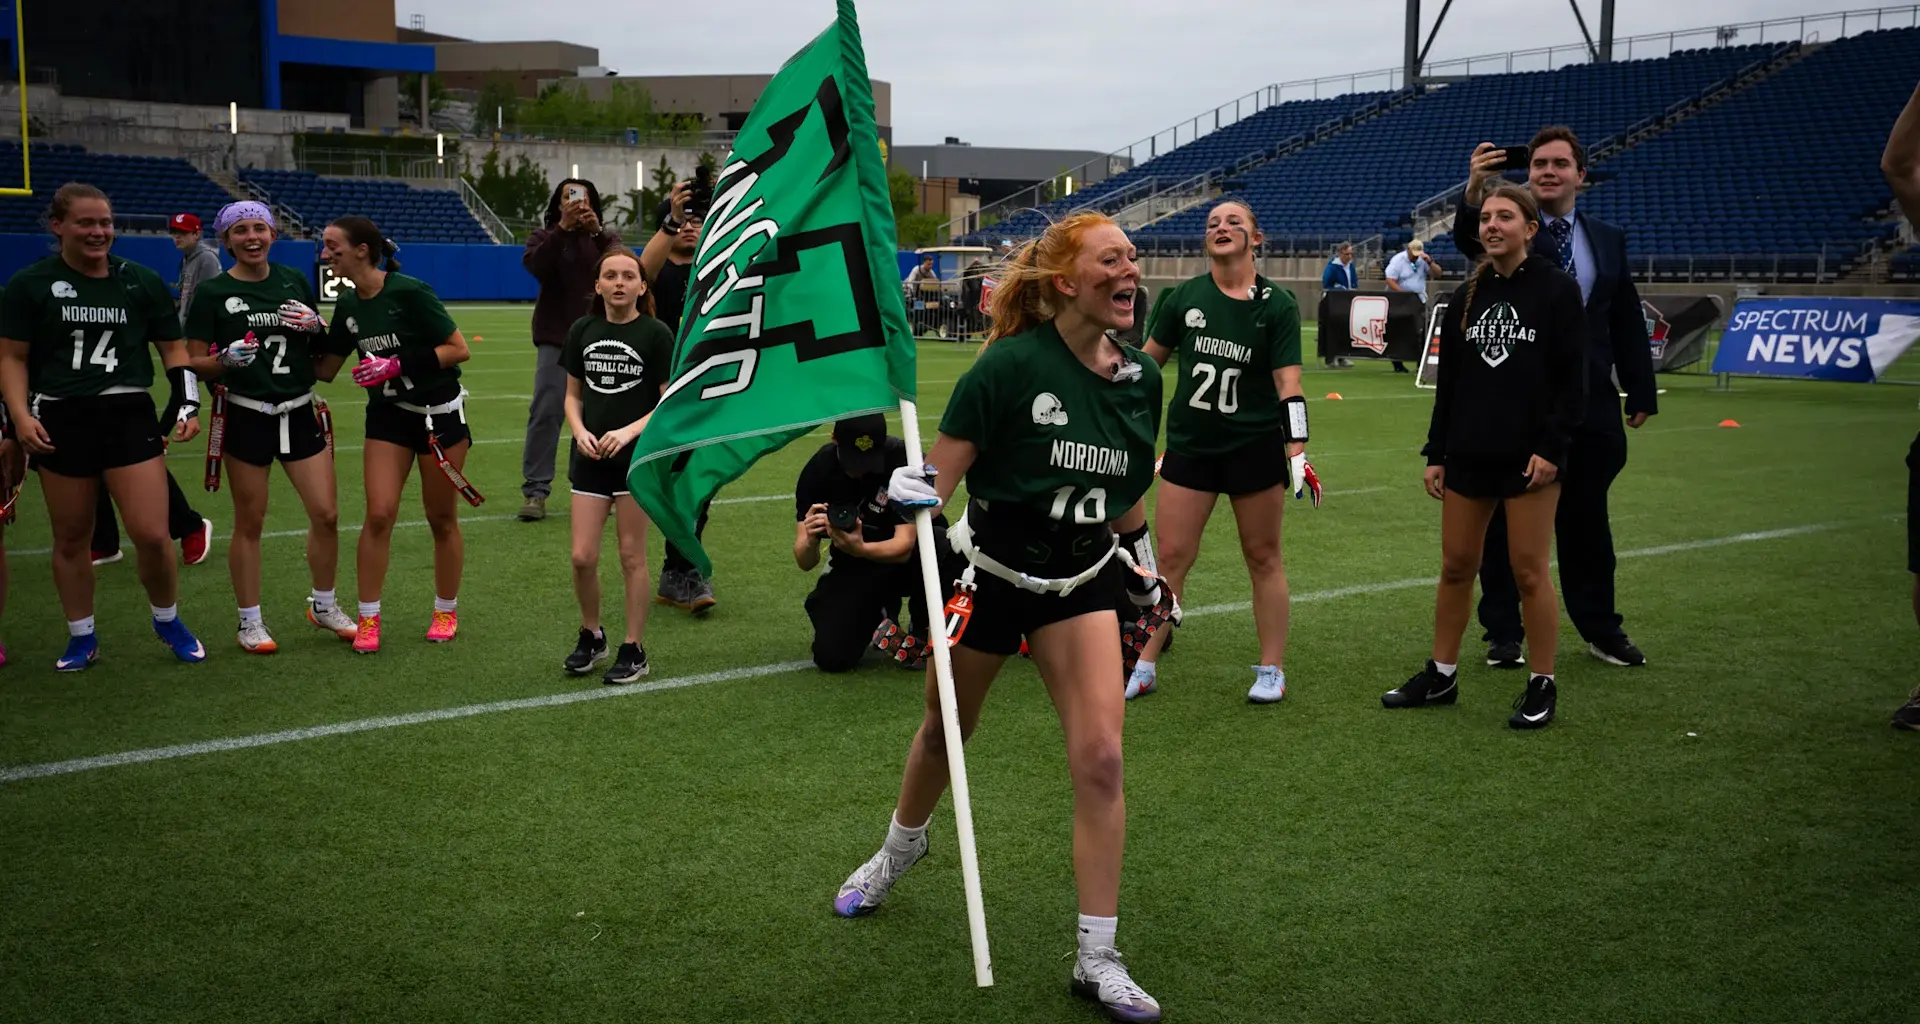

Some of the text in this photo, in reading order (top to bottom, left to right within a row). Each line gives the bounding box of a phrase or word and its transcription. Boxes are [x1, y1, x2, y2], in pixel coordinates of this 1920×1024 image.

[61, 305, 128, 324] NORDONIA
[246, 312, 281, 327] NORD
[1730, 309, 1868, 334] SPECTRUM
[69, 329, 119, 373] 14
[1193, 335, 1252, 364] NORDONIA
[1499, 325, 1537, 343] FLAG
[1746, 333, 1865, 369] NEWS
[263, 334, 291, 375] 2
[617, 362, 643, 376] CAMP
[1188, 362, 1242, 414] 20
[208, 416, 224, 457] BROWNS
[1049, 438, 1129, 477] NORDONIA
[1048, 485, 1107, 524] 10
